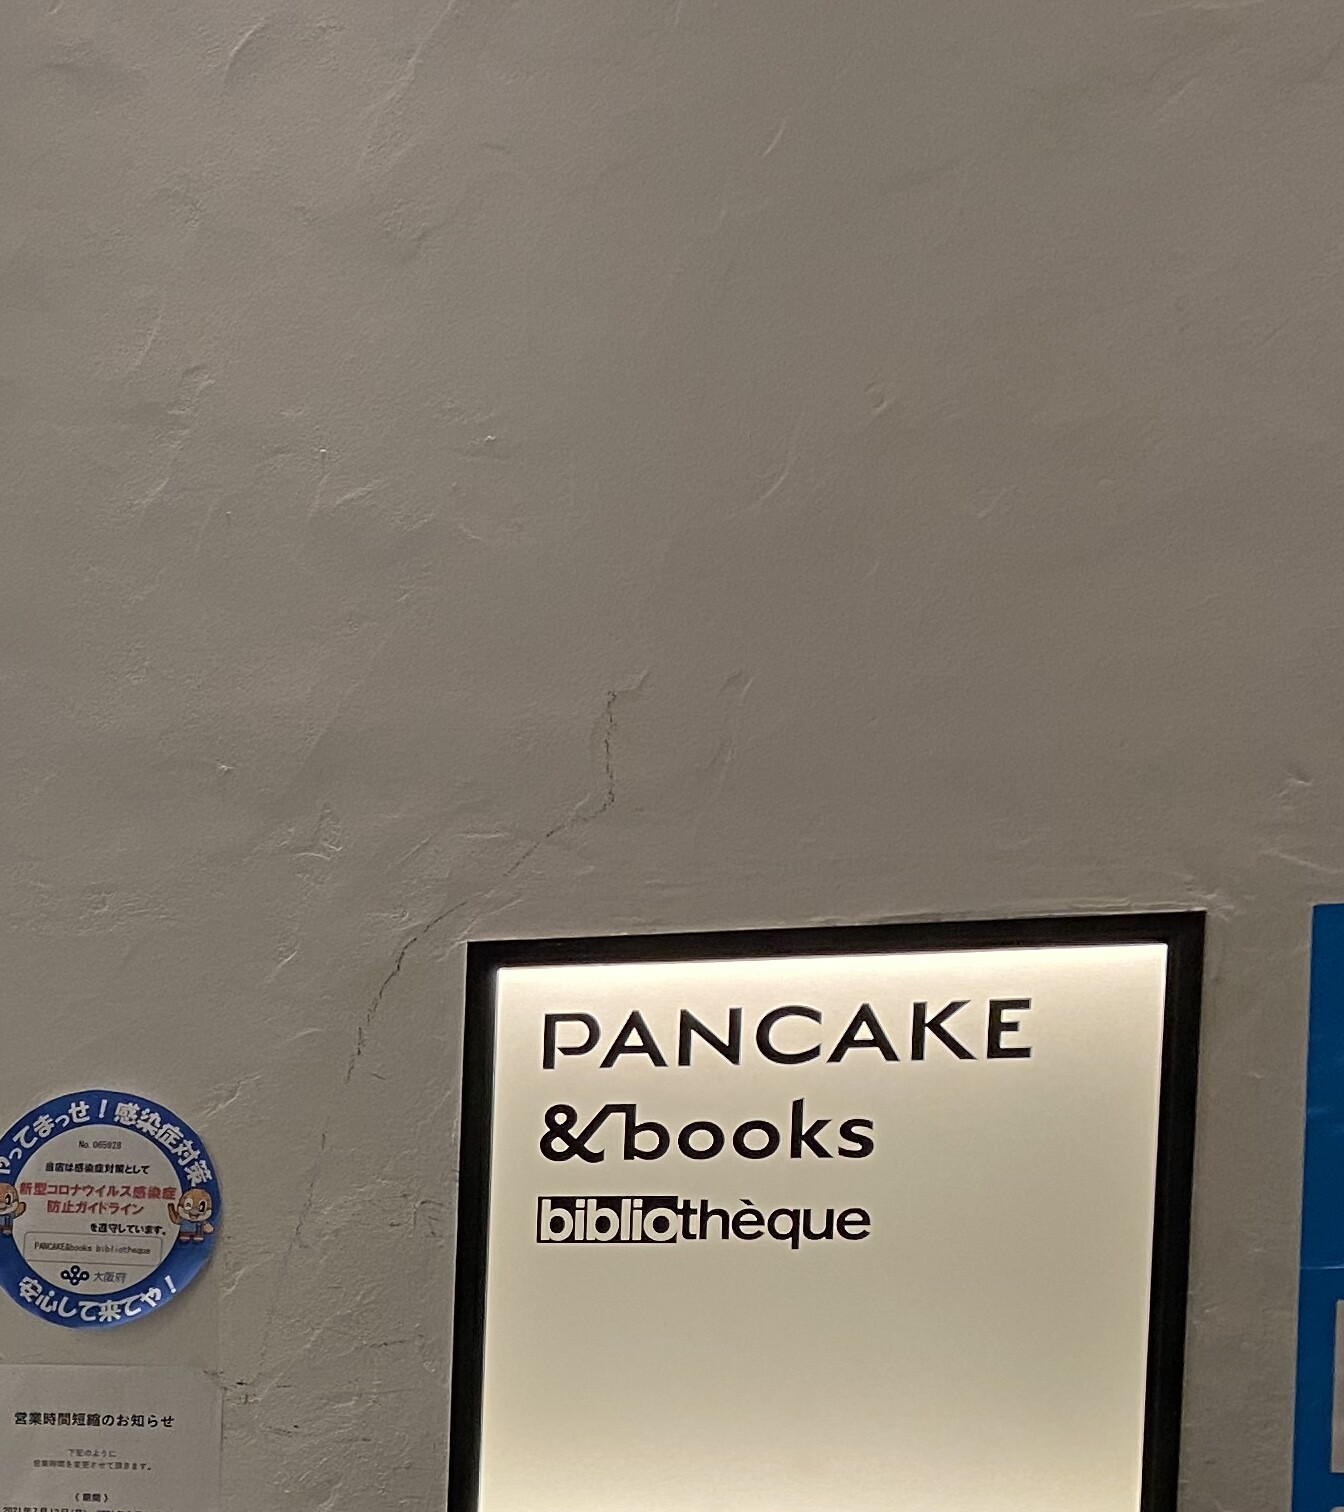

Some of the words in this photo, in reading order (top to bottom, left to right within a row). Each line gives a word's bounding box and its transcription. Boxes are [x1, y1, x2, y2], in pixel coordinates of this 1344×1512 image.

[542, 997, 1033, 1071] PANCAKE
[20, 1182, 176, 1200] 新型コロナウイルス感染症
[47, 1201, 144, 1215] 防止ガイドライン
[536, 1195, 872, 1249] bibliothèque
[93, 1271, 127, 1284] 大阪府
[14, 1412, 174, 1428] 営業時間短縮のお知らせ
